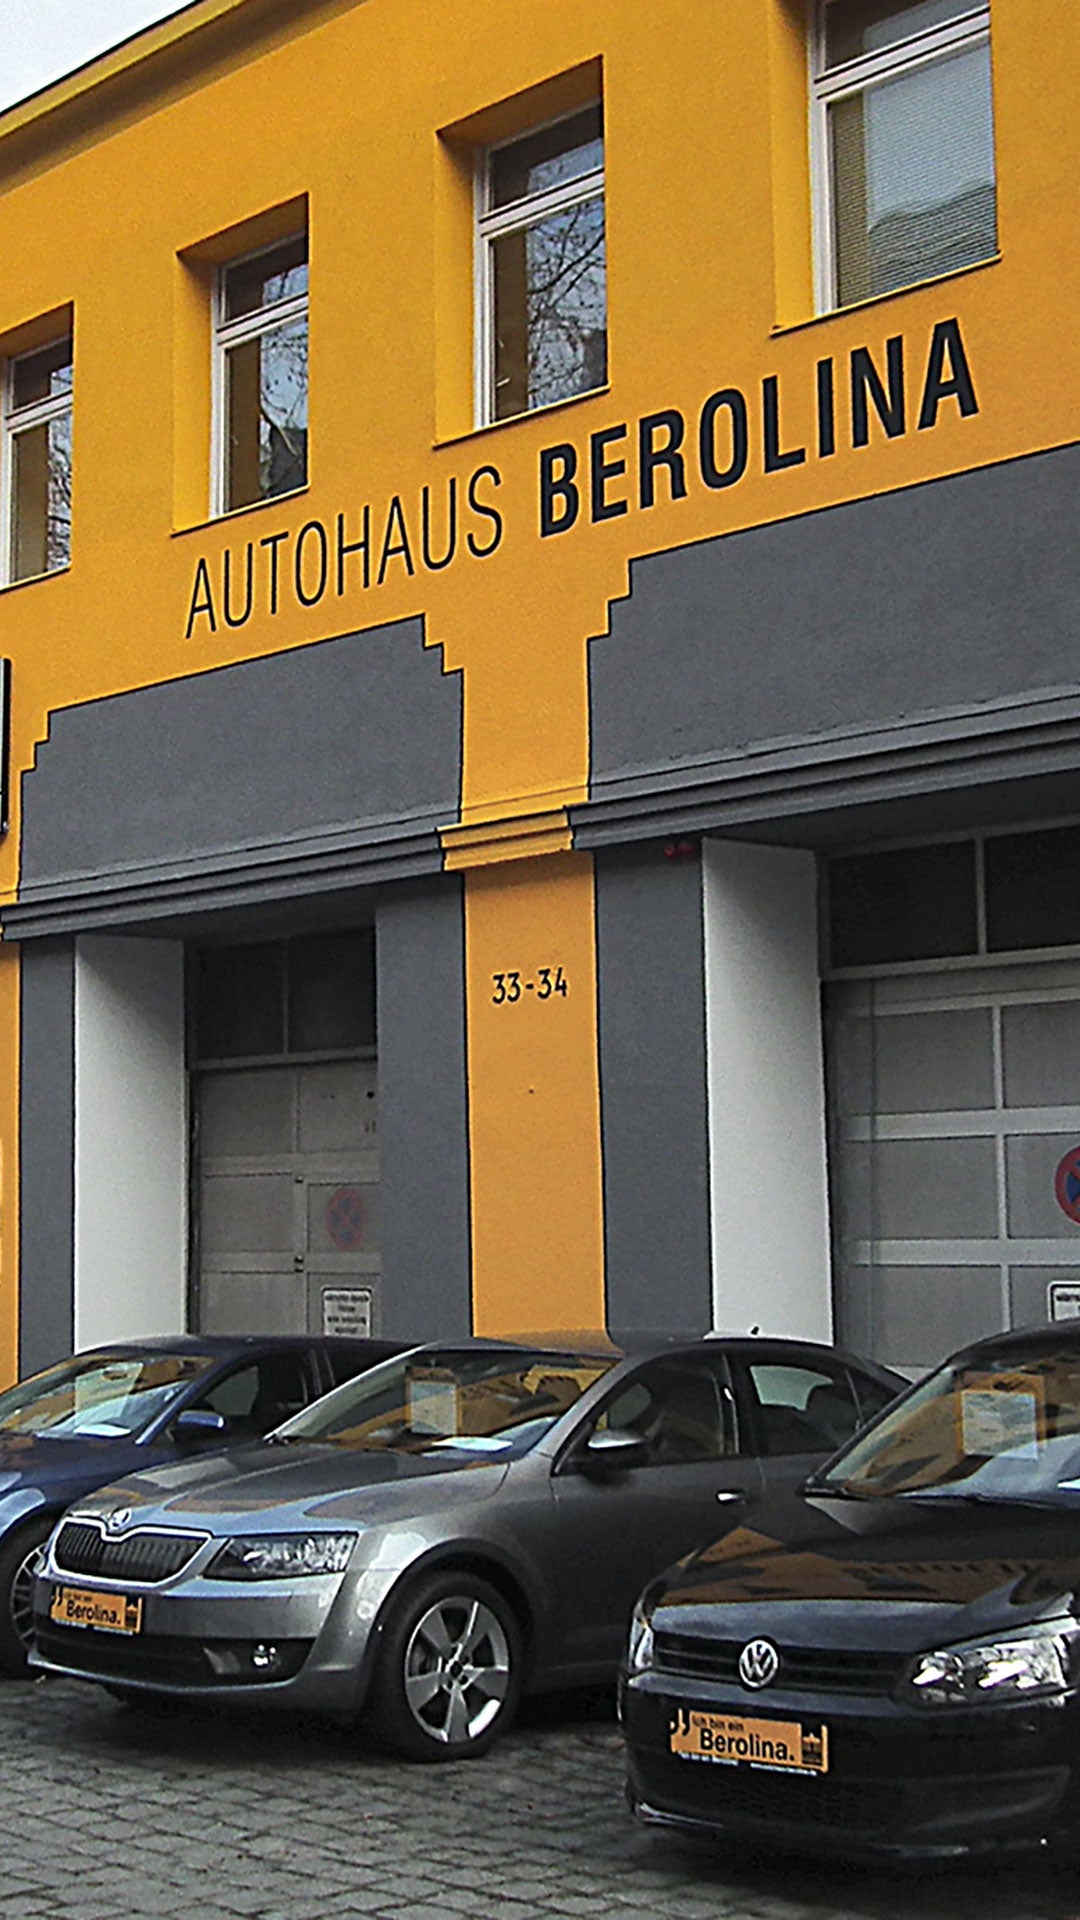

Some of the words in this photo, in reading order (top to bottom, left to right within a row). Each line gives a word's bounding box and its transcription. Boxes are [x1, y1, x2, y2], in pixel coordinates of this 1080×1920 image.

[185, 465, 503, 639] AUTOHAUS
[540, 317, 980, 538] BEROLINA
[492, 966, 567, 1004] 33-34
[700, 1727, 796, 1762] Berolina.
